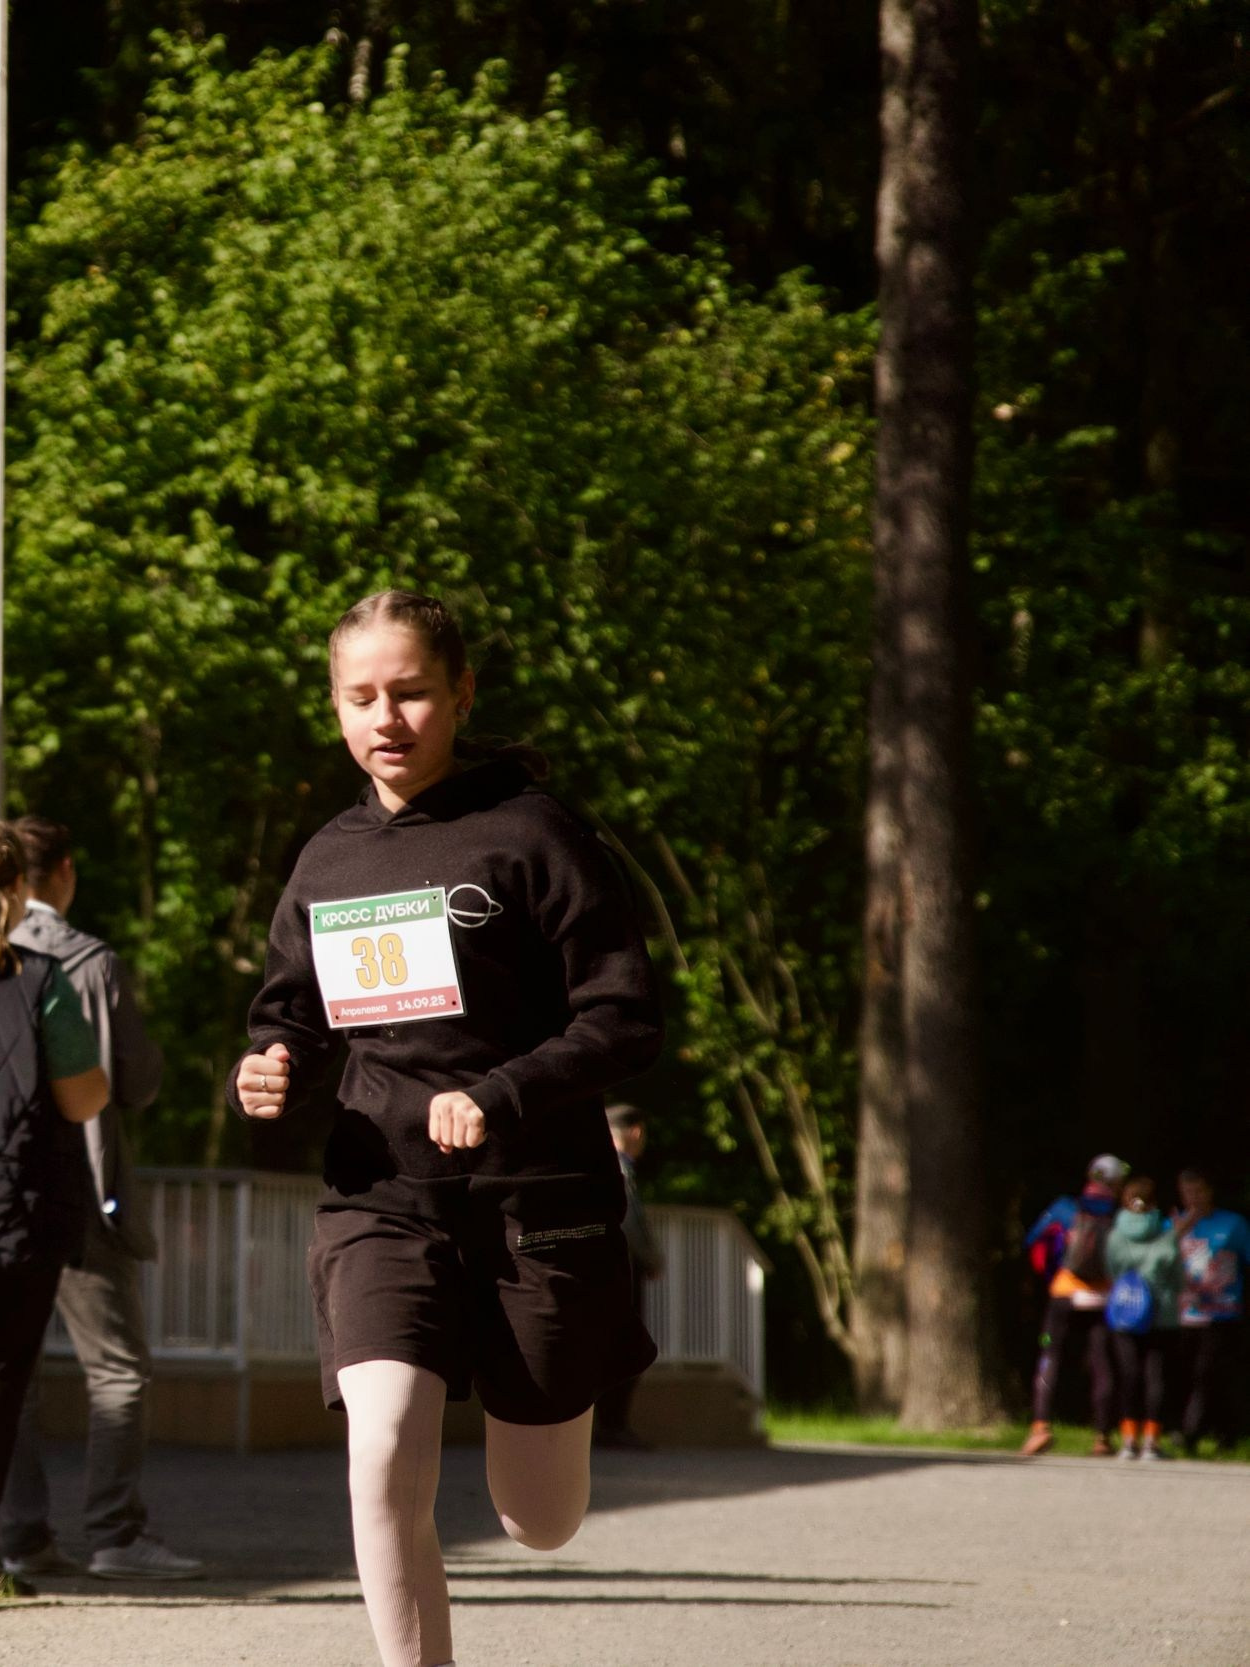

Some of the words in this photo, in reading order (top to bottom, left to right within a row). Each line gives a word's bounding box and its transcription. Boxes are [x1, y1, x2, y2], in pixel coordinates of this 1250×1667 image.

[321, 908, 372, 927] КРОСС
[375, 899, 430, 922] ДУБКИ
[351, 933, 408, 989] 38
[341, 1004, 388, 1017] Апрелевка
[396, 995, 446, 1012] 14.09.25
